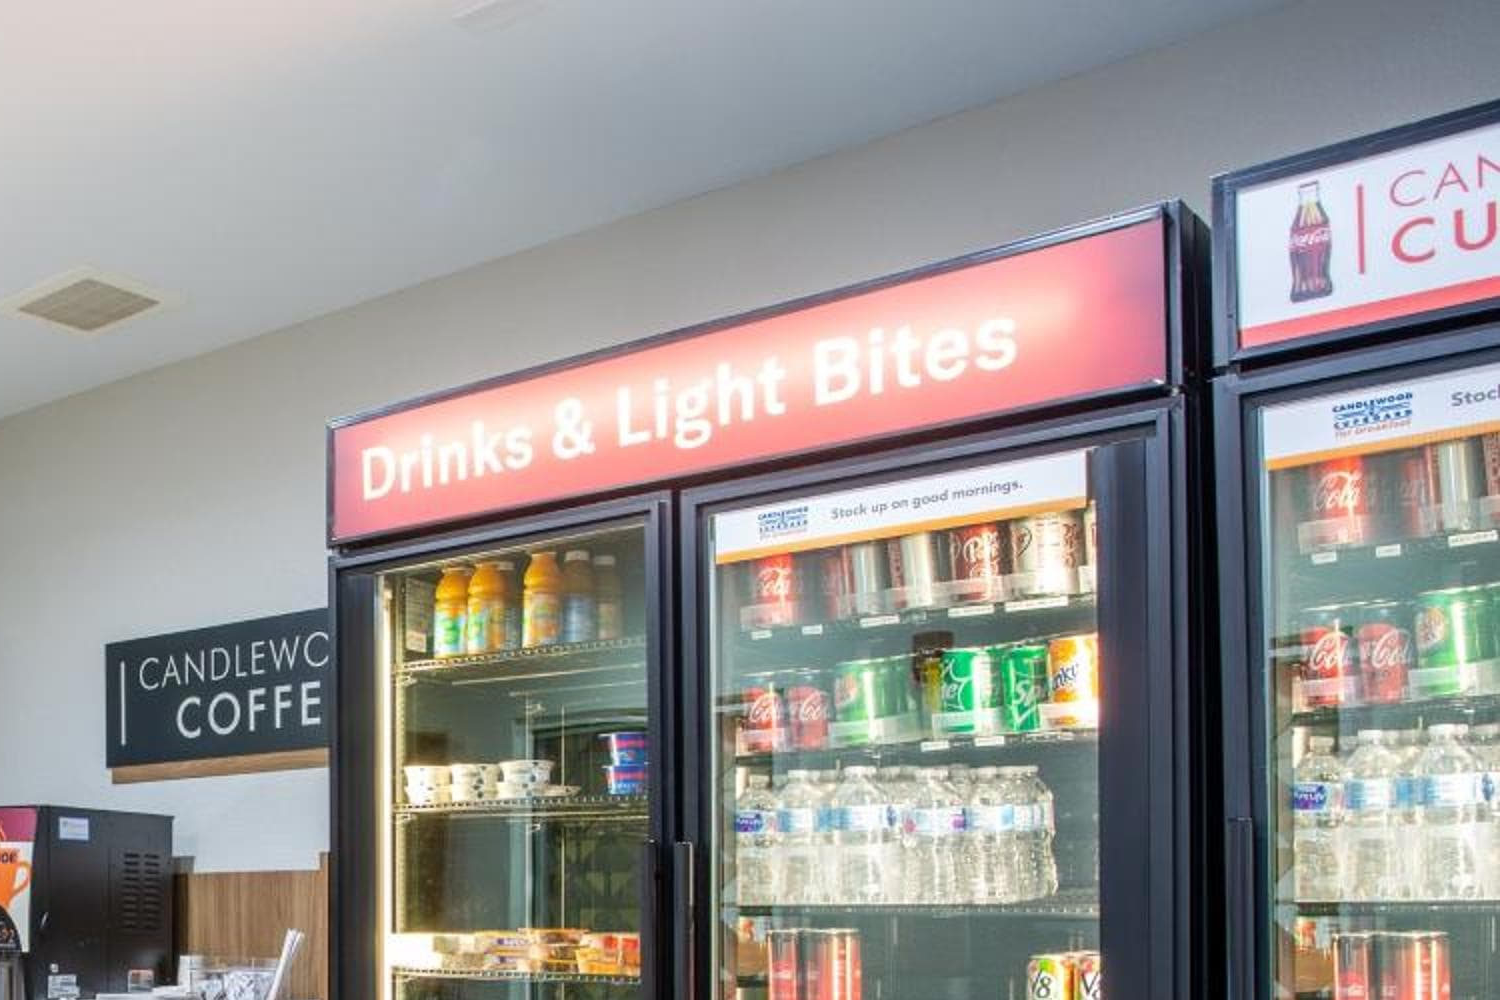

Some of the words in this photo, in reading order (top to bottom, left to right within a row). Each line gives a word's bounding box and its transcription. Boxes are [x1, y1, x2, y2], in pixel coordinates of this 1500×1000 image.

[1390, 202, 1498, 264] CU
[361, 424, 533, 501] Drinks
[552, 397, 596, 459] &
[617, 349, 786, 449] Light
[814, 315, 1018, 406] Bites
[1332, 391, 1413, 413] CANDLEWOOD
[1451, 384, 1500, 407] Stoc
[830, 503, 867, 520] Stock
[871, 501, 888, 514] up
[891, 499, 909, 509] on
[912, 489, 950, 509] good
[951, 479, 1024, 500] mornings.
[176, 681, 321, 739] COFFE
